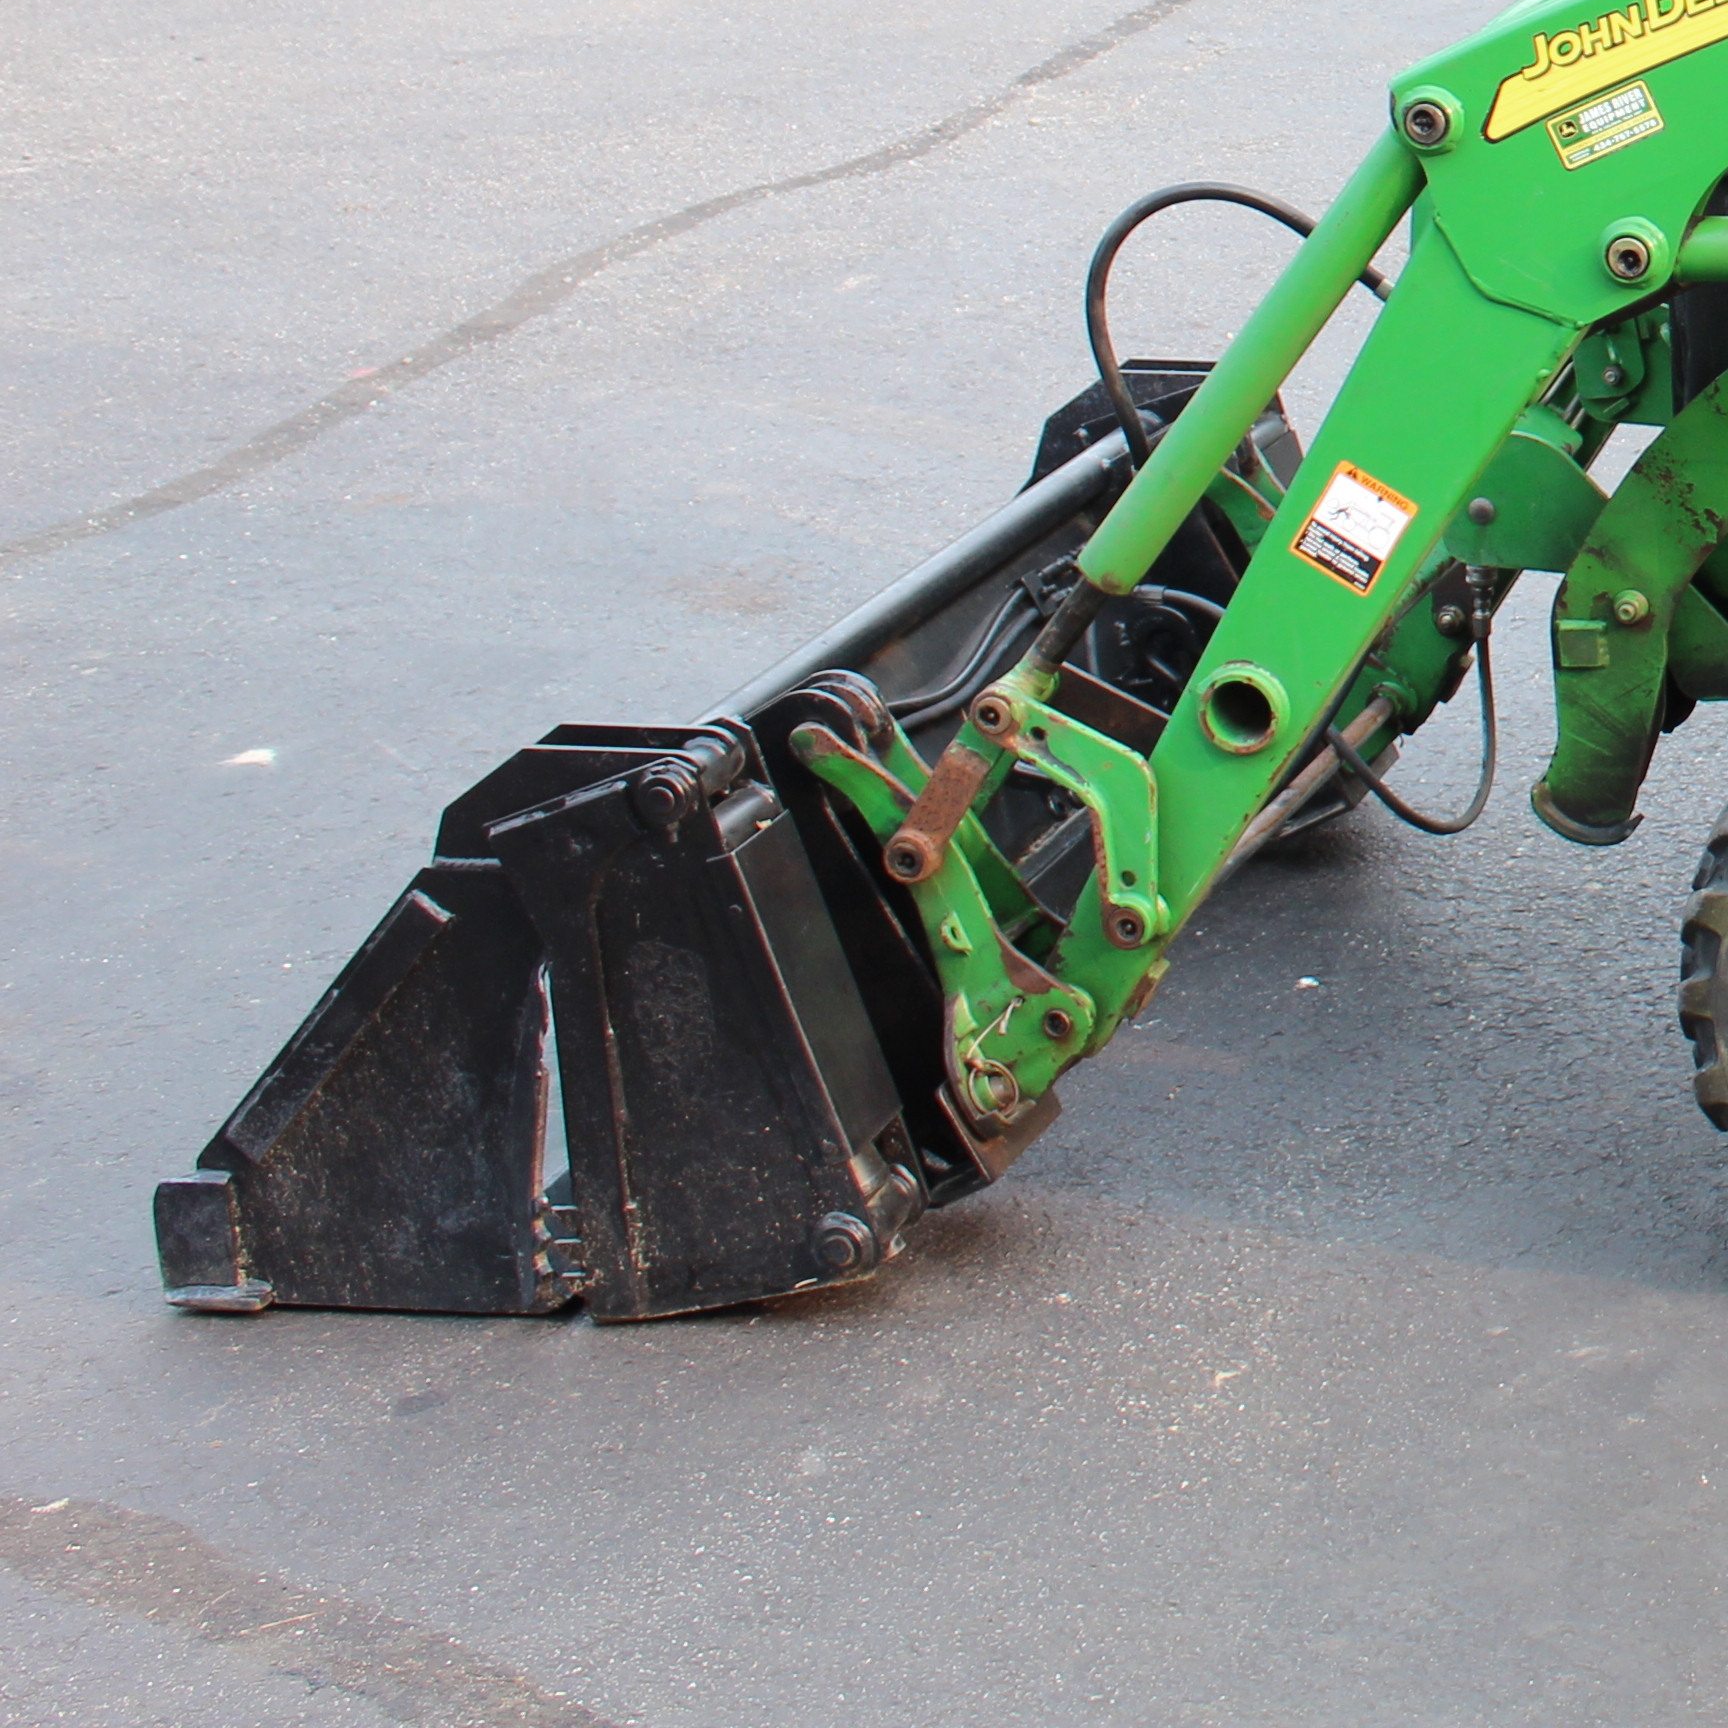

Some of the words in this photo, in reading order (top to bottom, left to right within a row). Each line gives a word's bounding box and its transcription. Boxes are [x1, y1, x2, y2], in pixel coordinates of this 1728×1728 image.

[1522, 3, 1645, 81] JOHN
[1578, 100, 1612, 125] JAMES
[1611, 87, 1643, 110] RIVER
[1581, 98, 1646, 134] EQUIPMENT
[1360, 475, 1409, 511] WARNING
